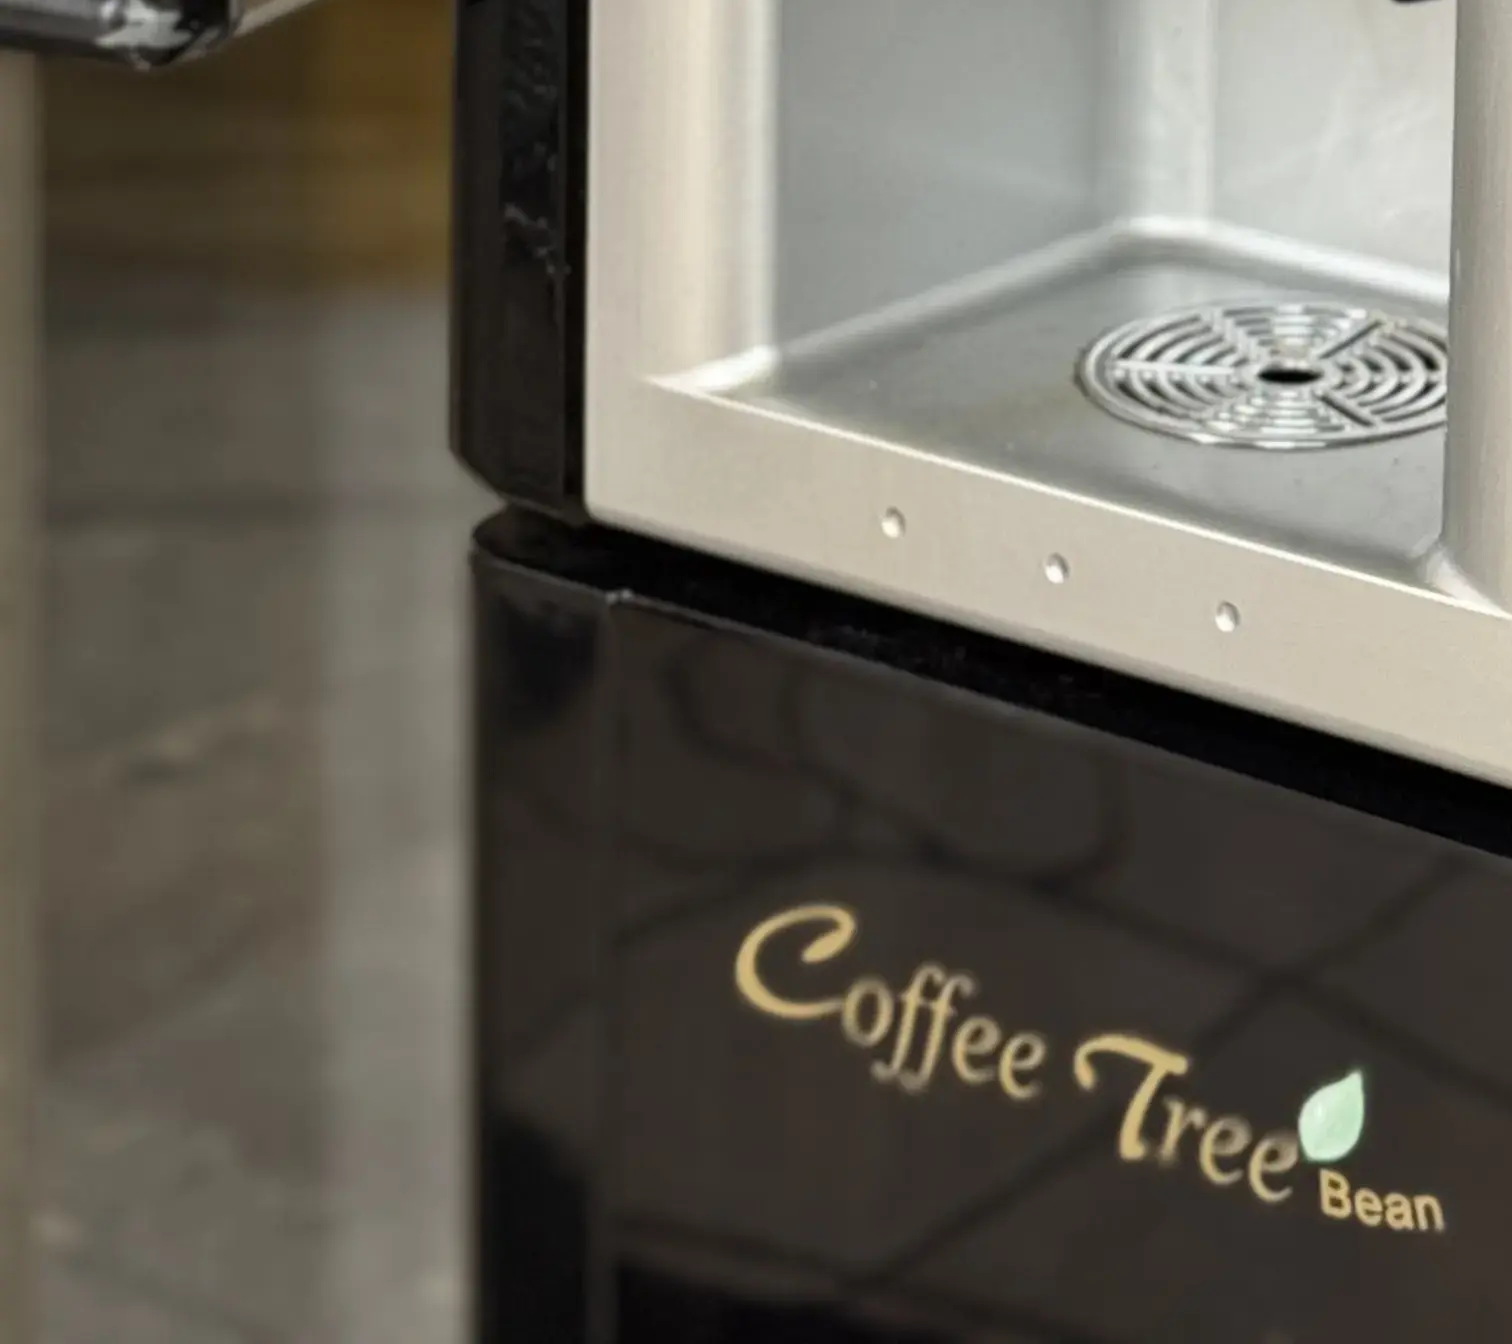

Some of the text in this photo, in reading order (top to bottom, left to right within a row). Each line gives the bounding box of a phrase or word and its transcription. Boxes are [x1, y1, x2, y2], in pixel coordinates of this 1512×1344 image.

[734, 903, 1303, 1205] Coffee Tree
[1319, 1168, 1445, 1235] Bean
